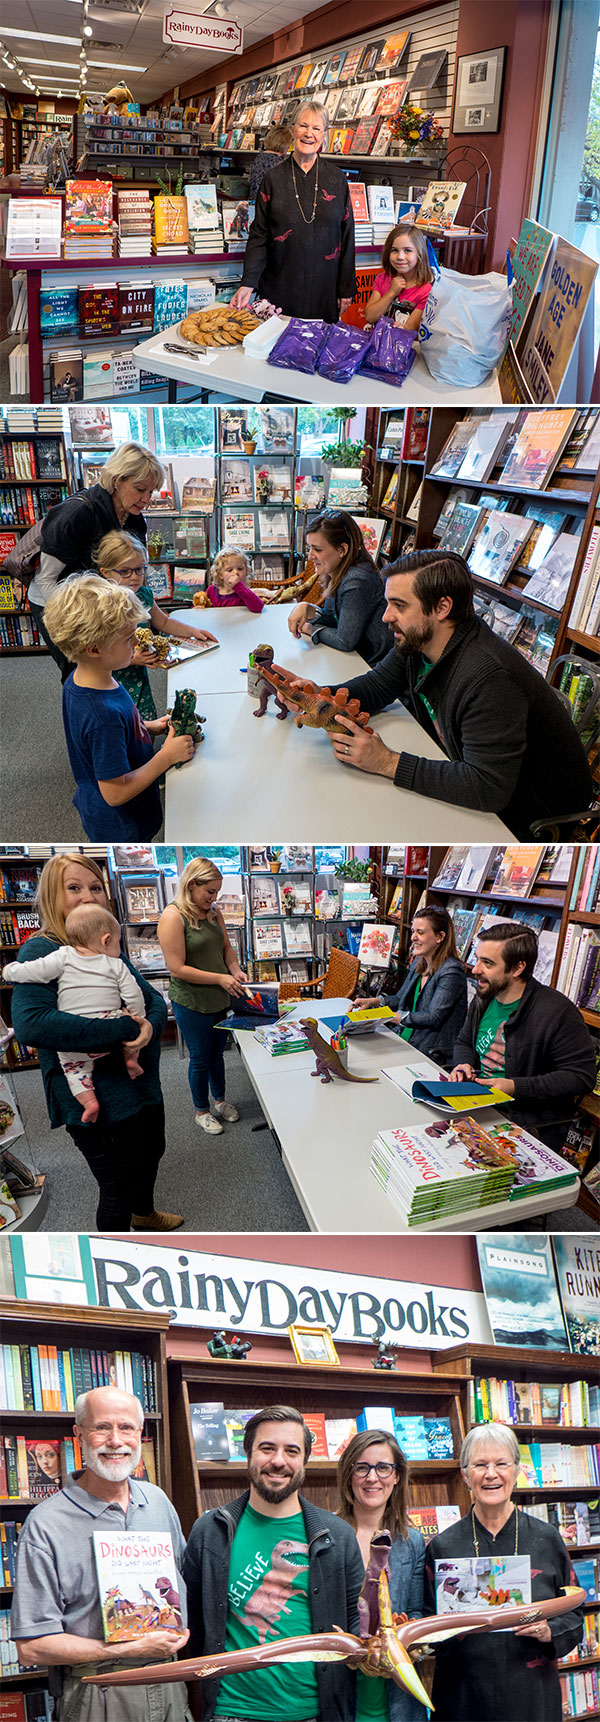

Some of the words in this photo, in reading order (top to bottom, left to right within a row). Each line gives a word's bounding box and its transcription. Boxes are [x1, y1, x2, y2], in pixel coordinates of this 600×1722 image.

[127, 291, 147, 301] CITY
[551, 259, 583, 309] GOLDEN
[121, 305, 133, 314] ON
[135, 303, 153, 313] FIRE
[547, 293, 566, 328] AGE
[535, 330, 555, 375] JANE
[18, 920, 40, 928] BACK
[391, 1128, 441, 1181] DINOSAURS
[514, 1134, 565, 1173] DINOSAURS
[489, 1253, 544, 1269] PLAINSONG
[422, 1515, 437, 1525] ARE
[99, 1541, 172, 1558] DINOSAURS
[228, 1551, 269, 1607] BELIEVE
